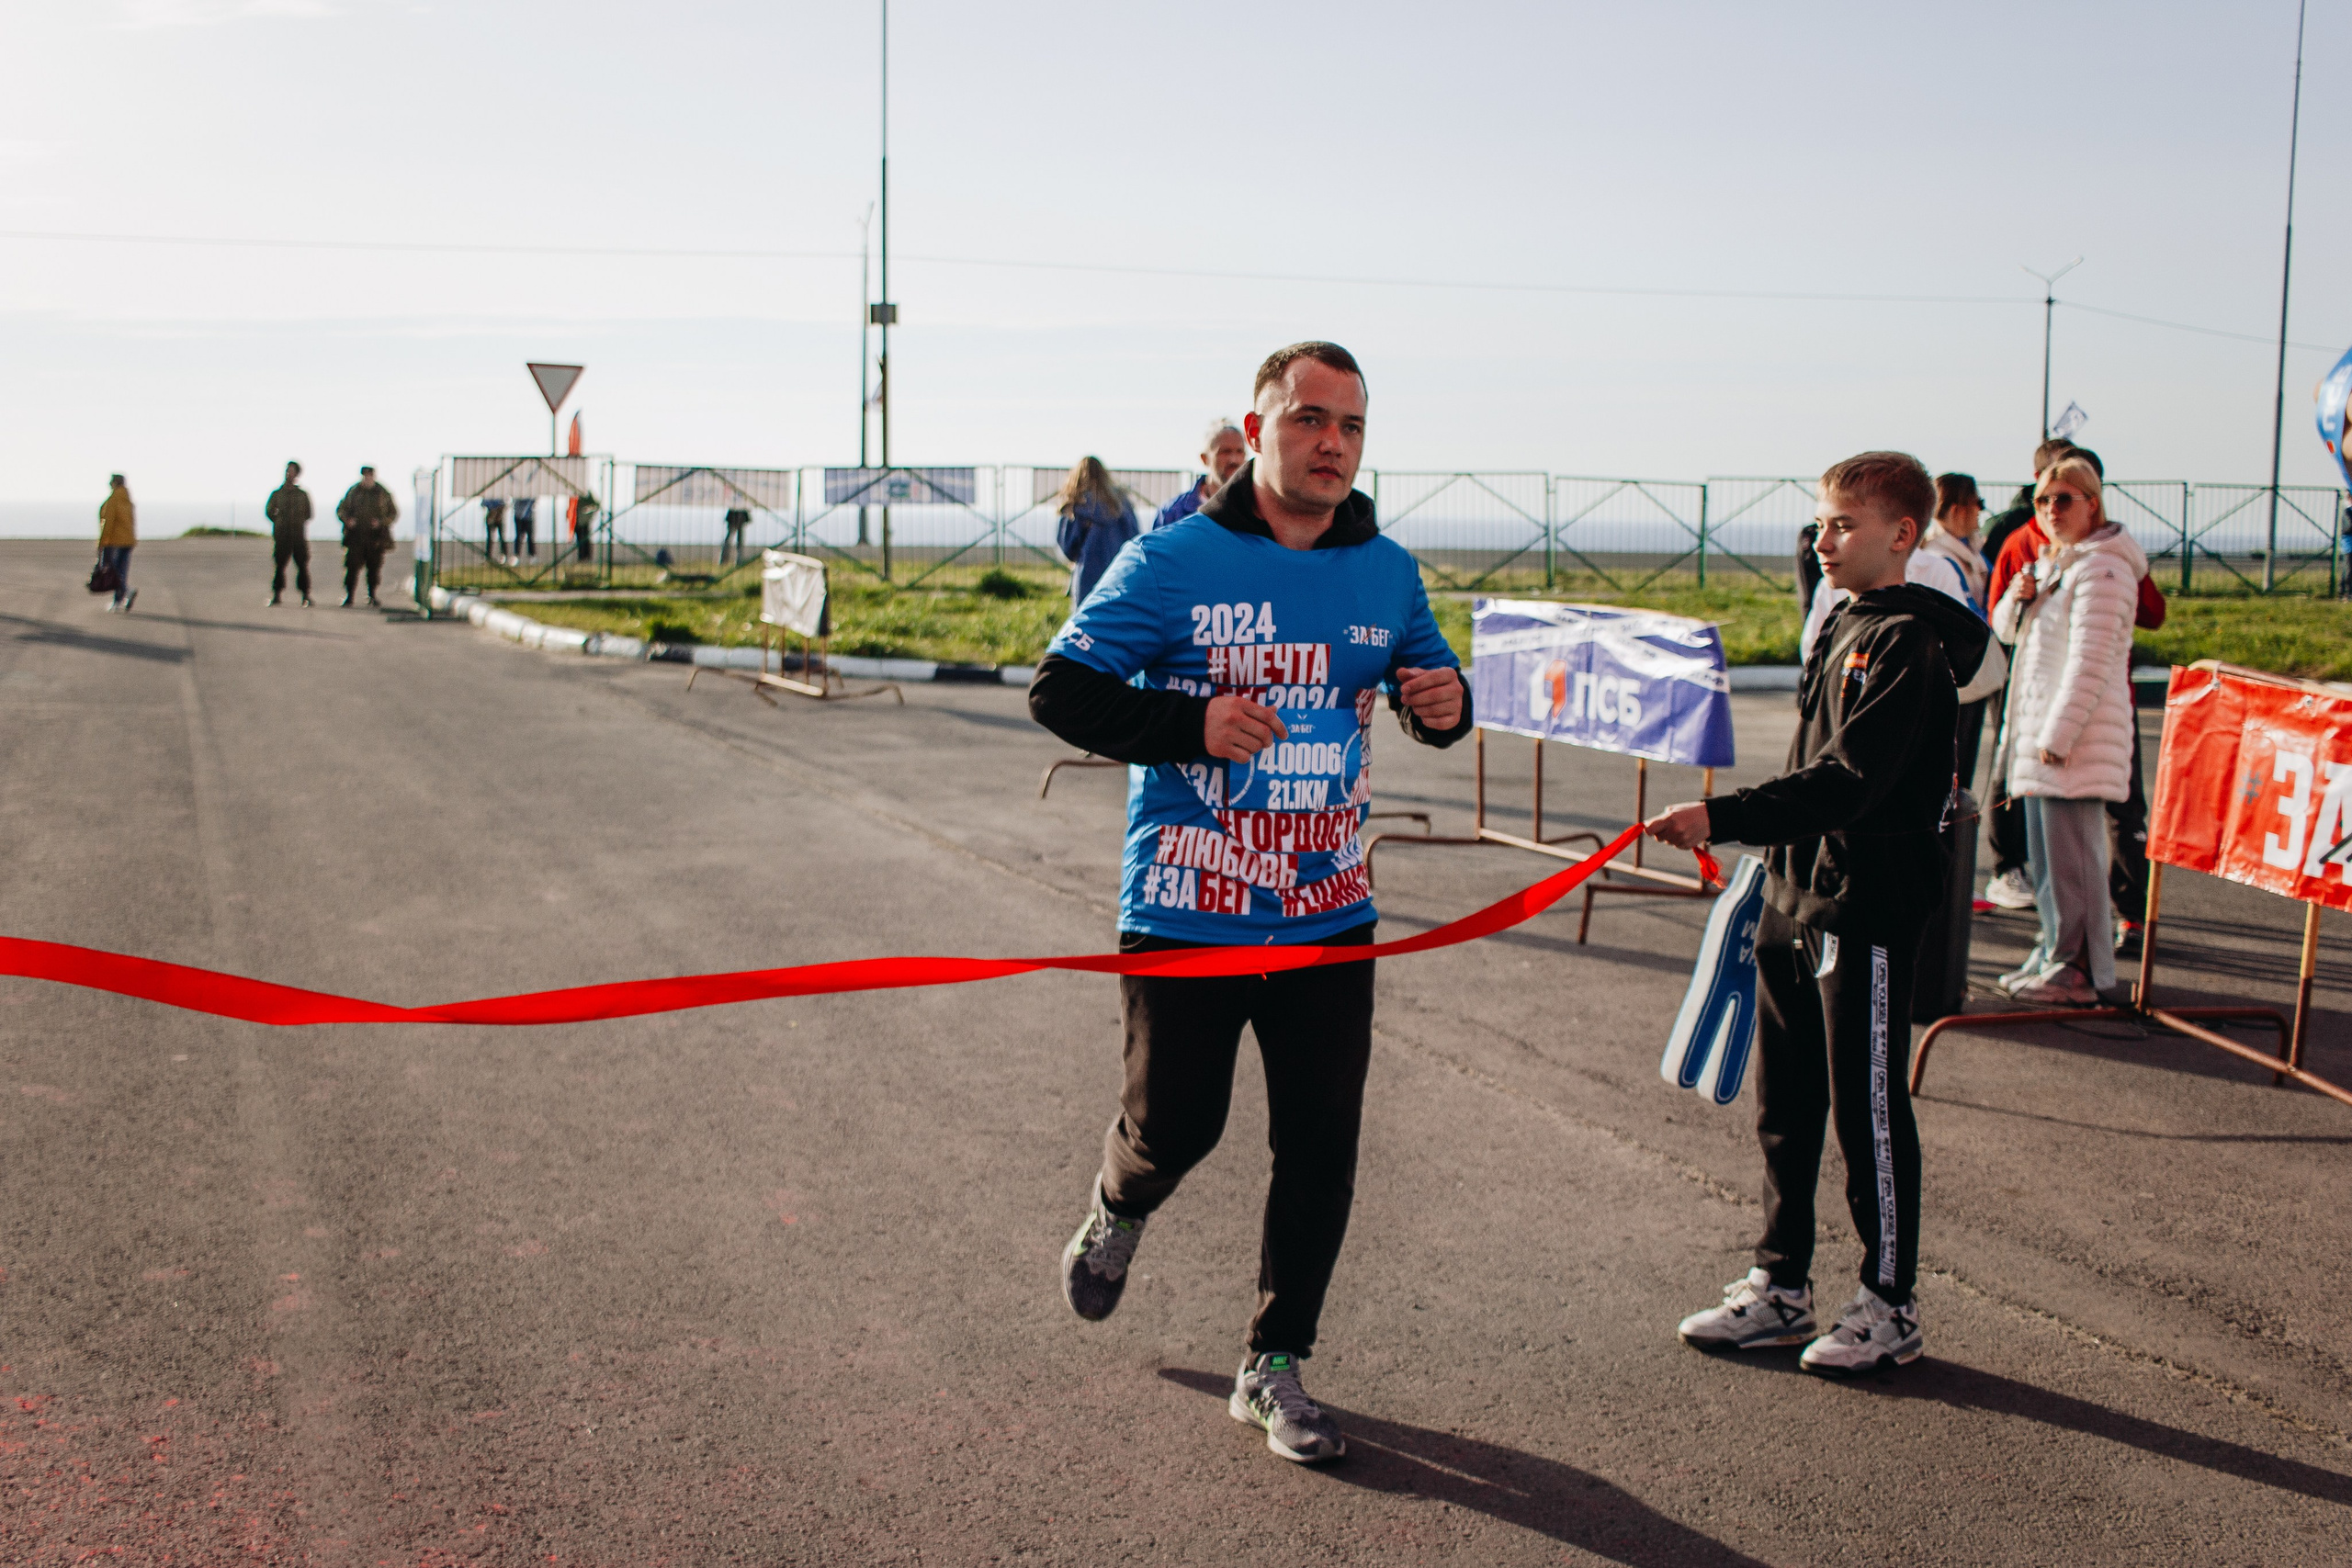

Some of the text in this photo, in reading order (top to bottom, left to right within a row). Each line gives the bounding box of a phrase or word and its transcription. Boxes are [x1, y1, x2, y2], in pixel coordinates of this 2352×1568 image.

[1192, 602, 1276, 646] 2024
[1207, 644, 1329, 685] #МЕЧТА
[1573, 671, 1642, 728] ПСБ
[1258, 742, 1341, 775] 40006
[1143, 864, 1251, 916] #ЗАБЕГ
[1878, 962, 1886, 984] OPEN
[1877, 1070, 1886, 1092] OPEN
